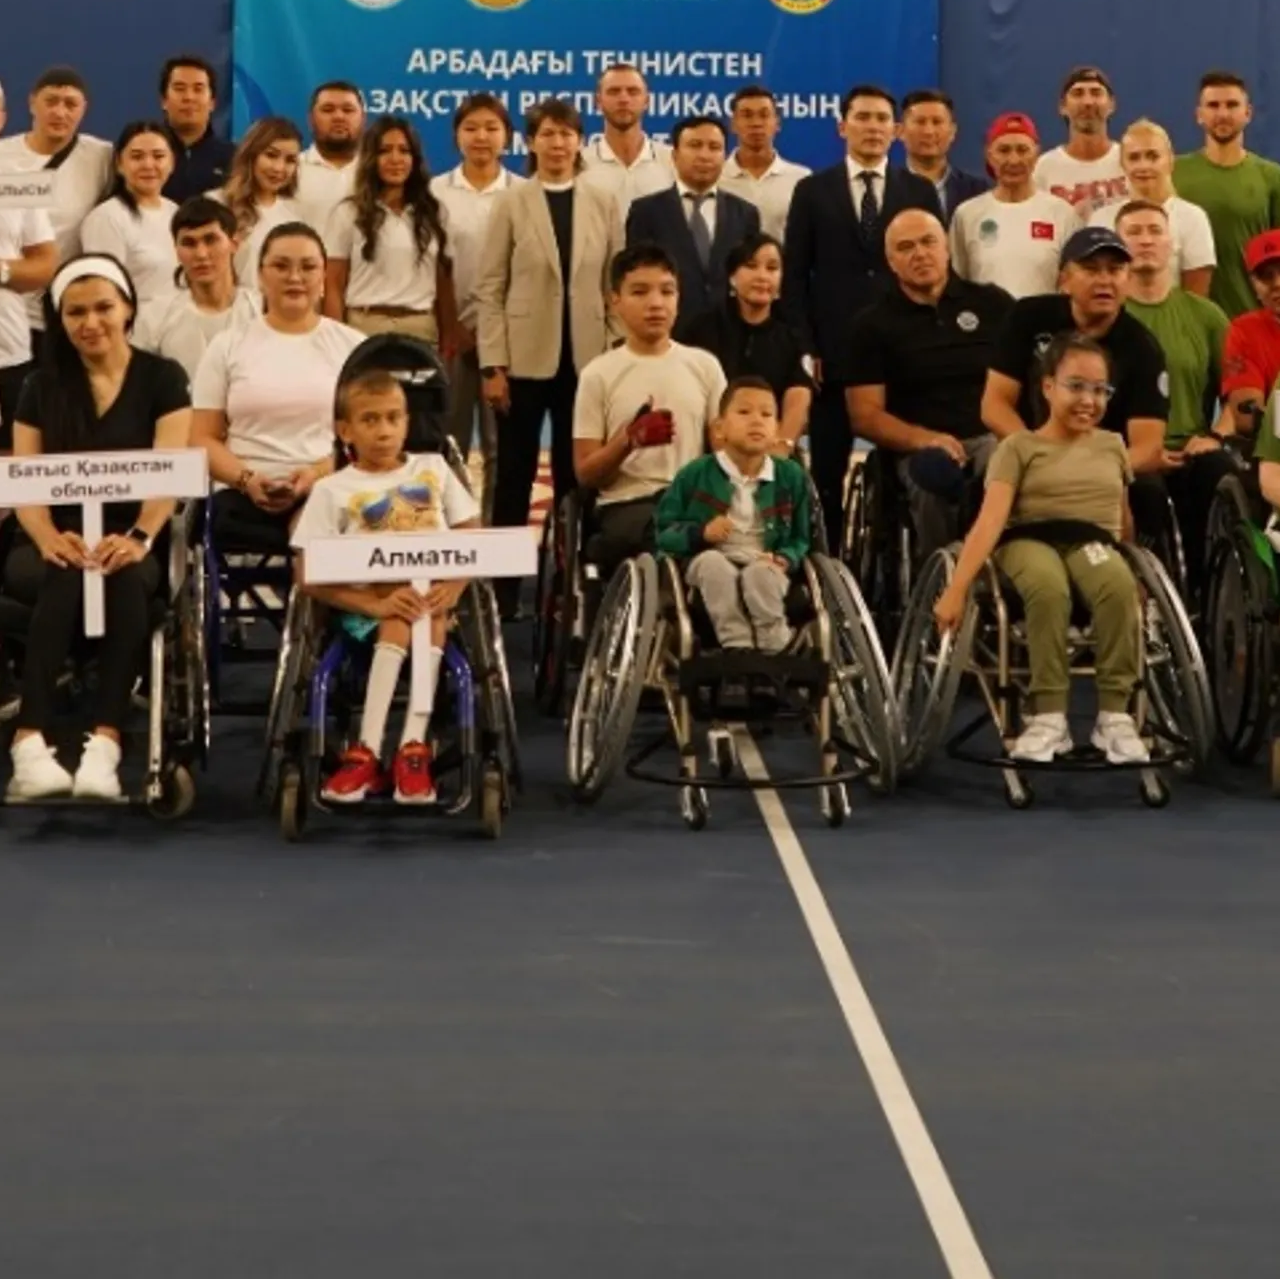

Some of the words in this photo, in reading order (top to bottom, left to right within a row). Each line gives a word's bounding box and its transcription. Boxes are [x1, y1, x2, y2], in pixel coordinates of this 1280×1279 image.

[407, 48, 573, 80] АРБАДАҒЫ
[581, 49, 763, 77] ТЕННИСТЕН
[358, 88, 510, 120] ЗАҚСТН
[8, 463, 70, 479] Батыс
[76, 459, 174, 477] Қазақстан
[50, 482, 132, 498] облысы
[368, 547, 477, 568] Алматы
